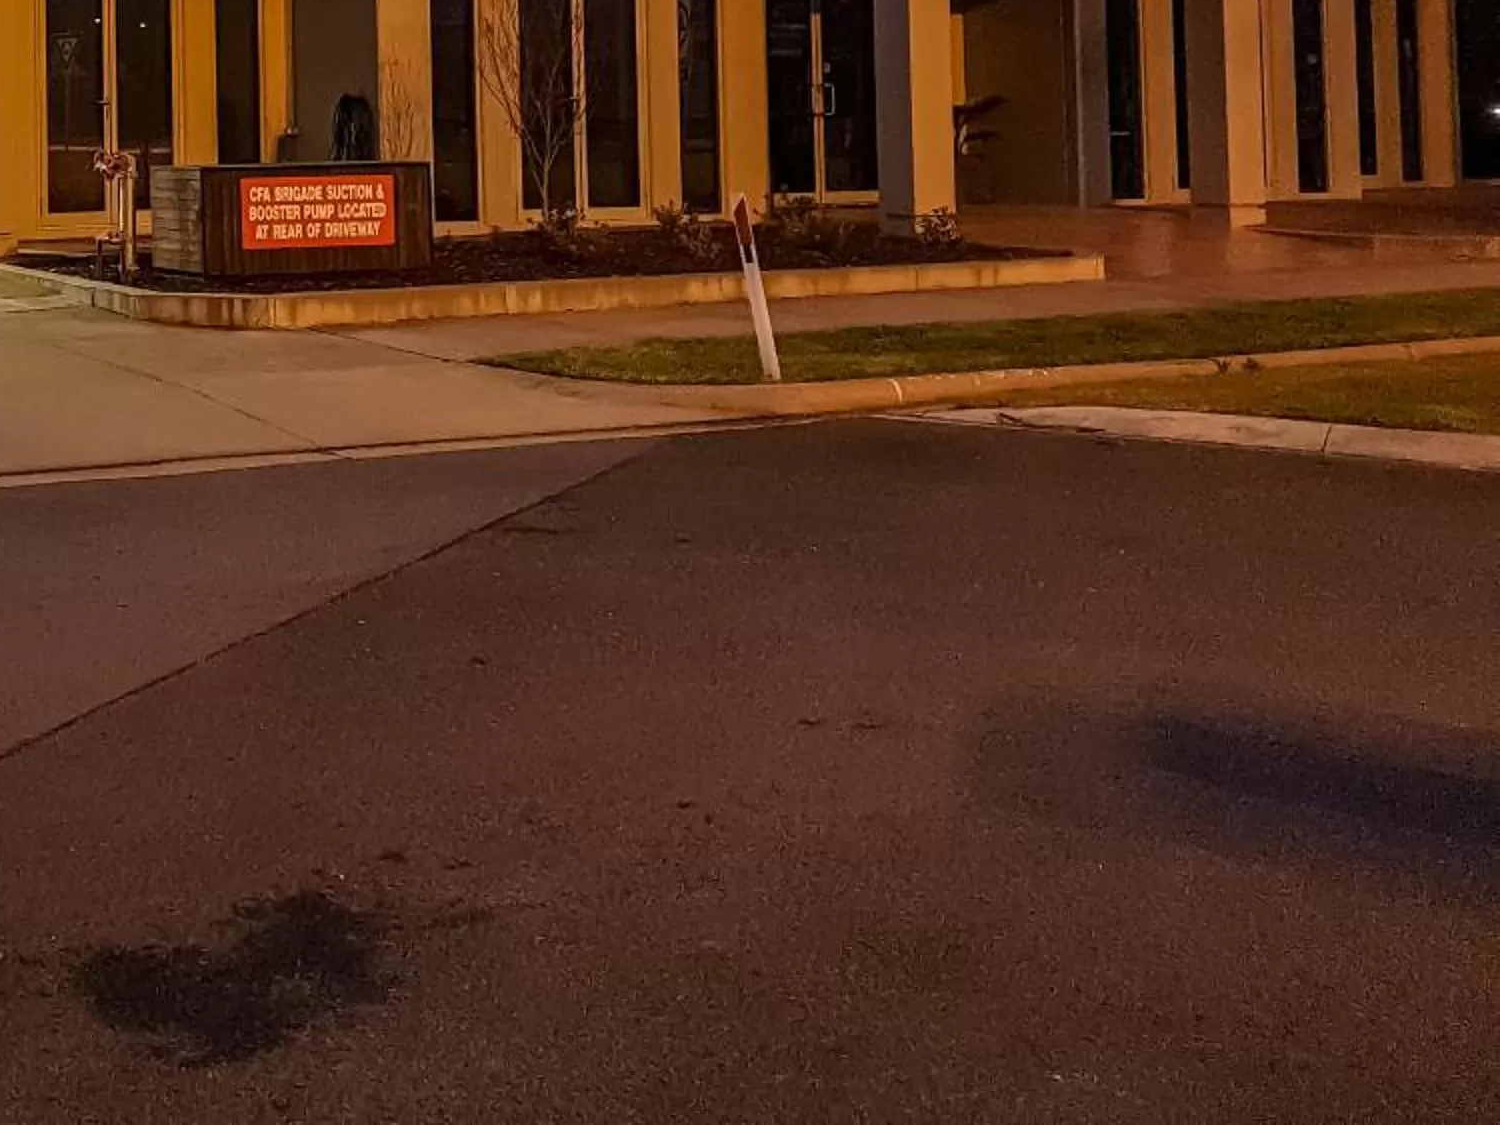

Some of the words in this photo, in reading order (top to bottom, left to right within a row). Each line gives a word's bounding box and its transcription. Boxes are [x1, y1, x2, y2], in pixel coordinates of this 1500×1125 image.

[249, 186, 271, 202] CFA
[275, 185, 323, 202] BRIGADE
[326, 184, 373, 200] SUCTION
[375, 183, 385, 200] &
[249, 204, 301, 221] BOOSTER
[303, 204, 335, 220] PUMP
[337, 202, 387, 218] LOCATED
[255, 225, 269, 240] AT
[273, 223, 303, 239] REAR
[305, 223, 322, 239] OF
[324, 221, 381, 238] DRIVEWAY
